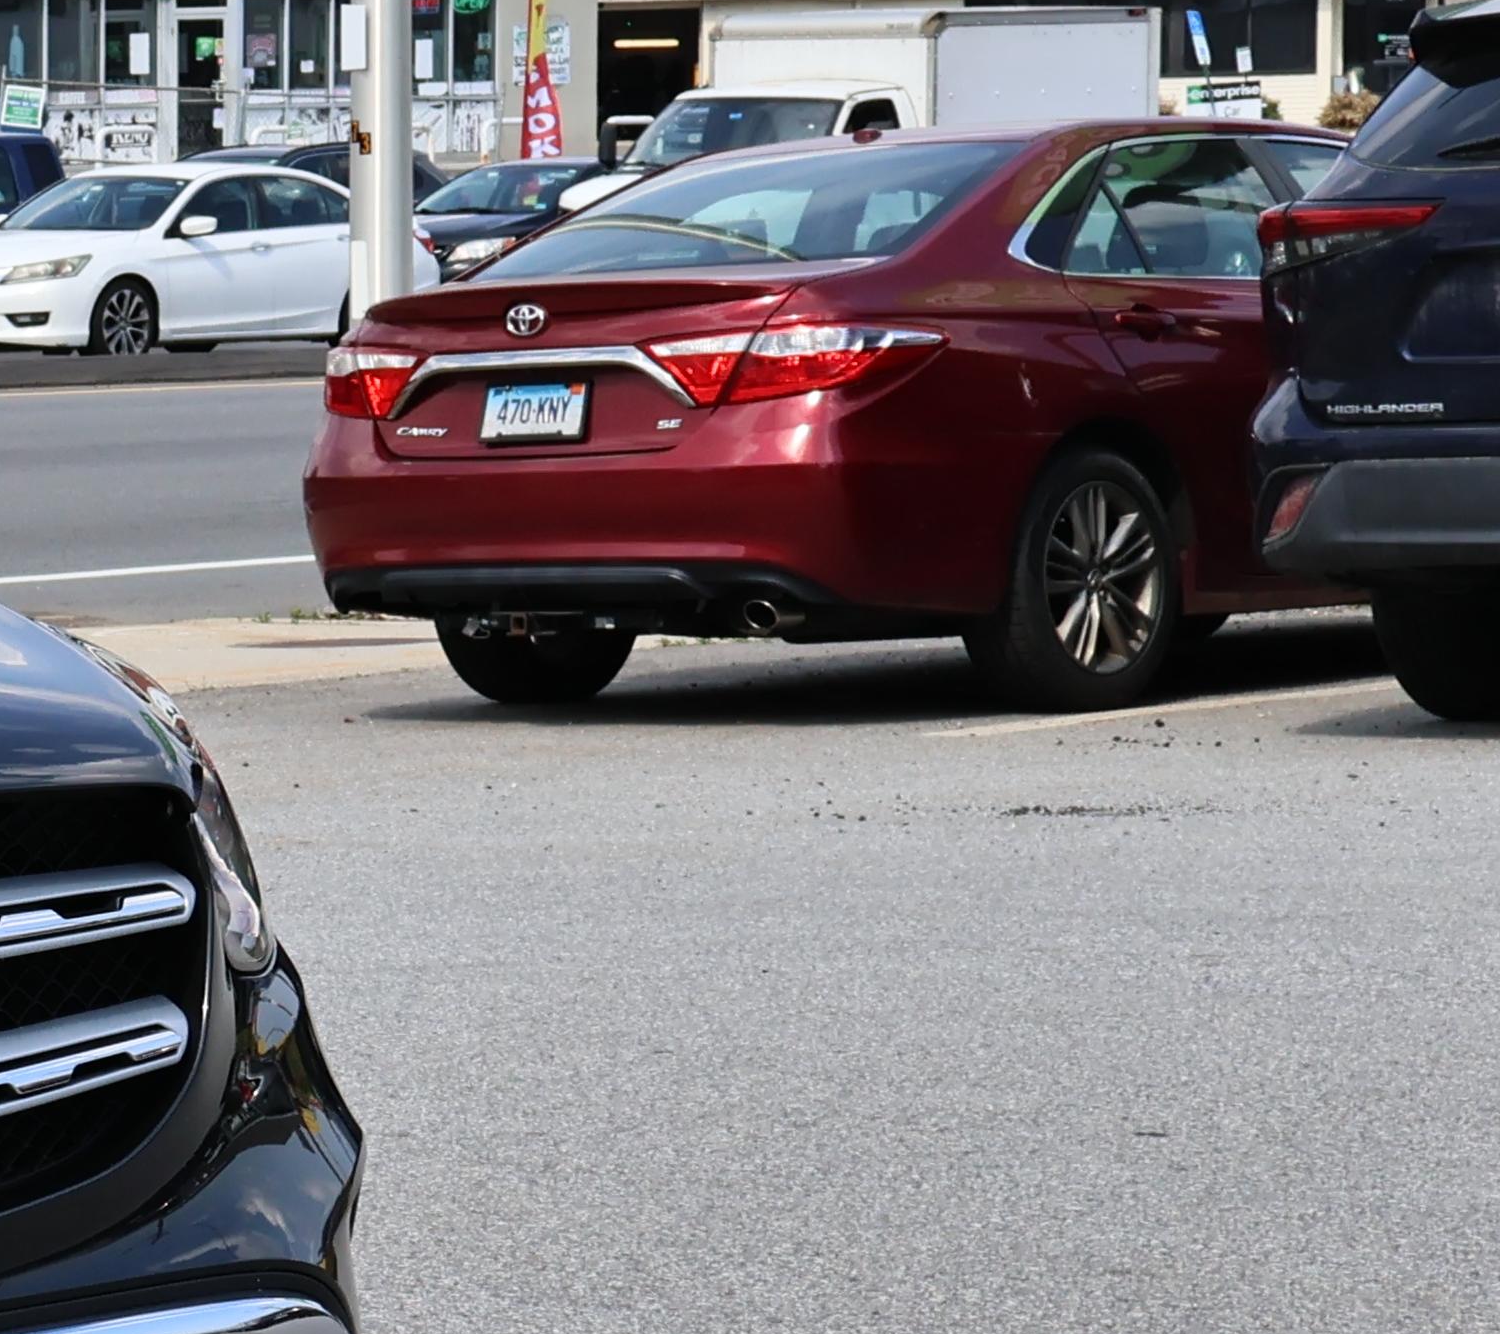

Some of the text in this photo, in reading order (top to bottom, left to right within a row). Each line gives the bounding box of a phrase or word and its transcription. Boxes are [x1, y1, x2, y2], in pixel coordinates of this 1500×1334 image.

[1326, 402, 1444, 414] HIGHLANDER
[396, 419, 682, 437] CAMRY SE
